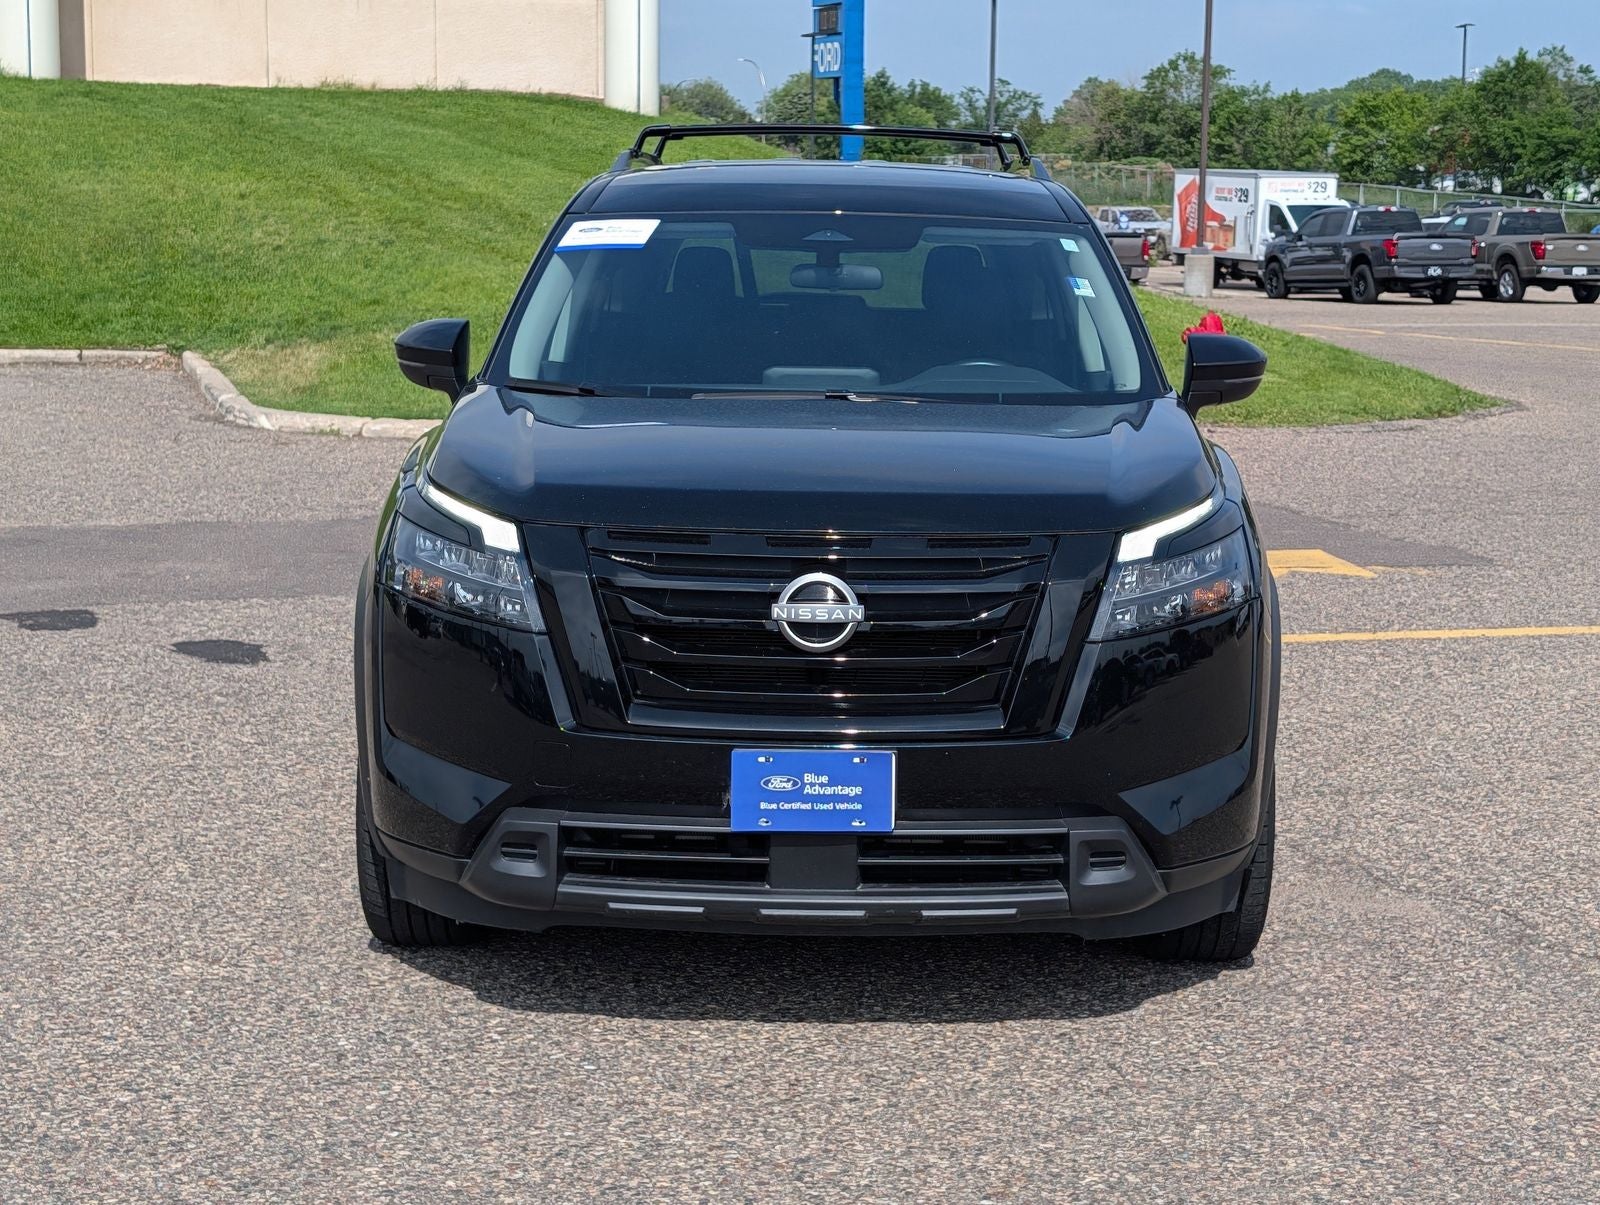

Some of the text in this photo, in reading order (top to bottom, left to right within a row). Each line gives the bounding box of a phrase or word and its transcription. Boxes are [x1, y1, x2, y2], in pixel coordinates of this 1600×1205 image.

[1307, 180, 1328, 193] $29
[1234, 187, 1249, 203] $29
[773, 607, 862, 620] NISSAN
[767, 777, 794, 790] Ford
[803, 773, 829, 784] Blue
[803, 785, 863, 797] Advantage
[760, 802, 863, 810] Blue Certified Used Vehicle
